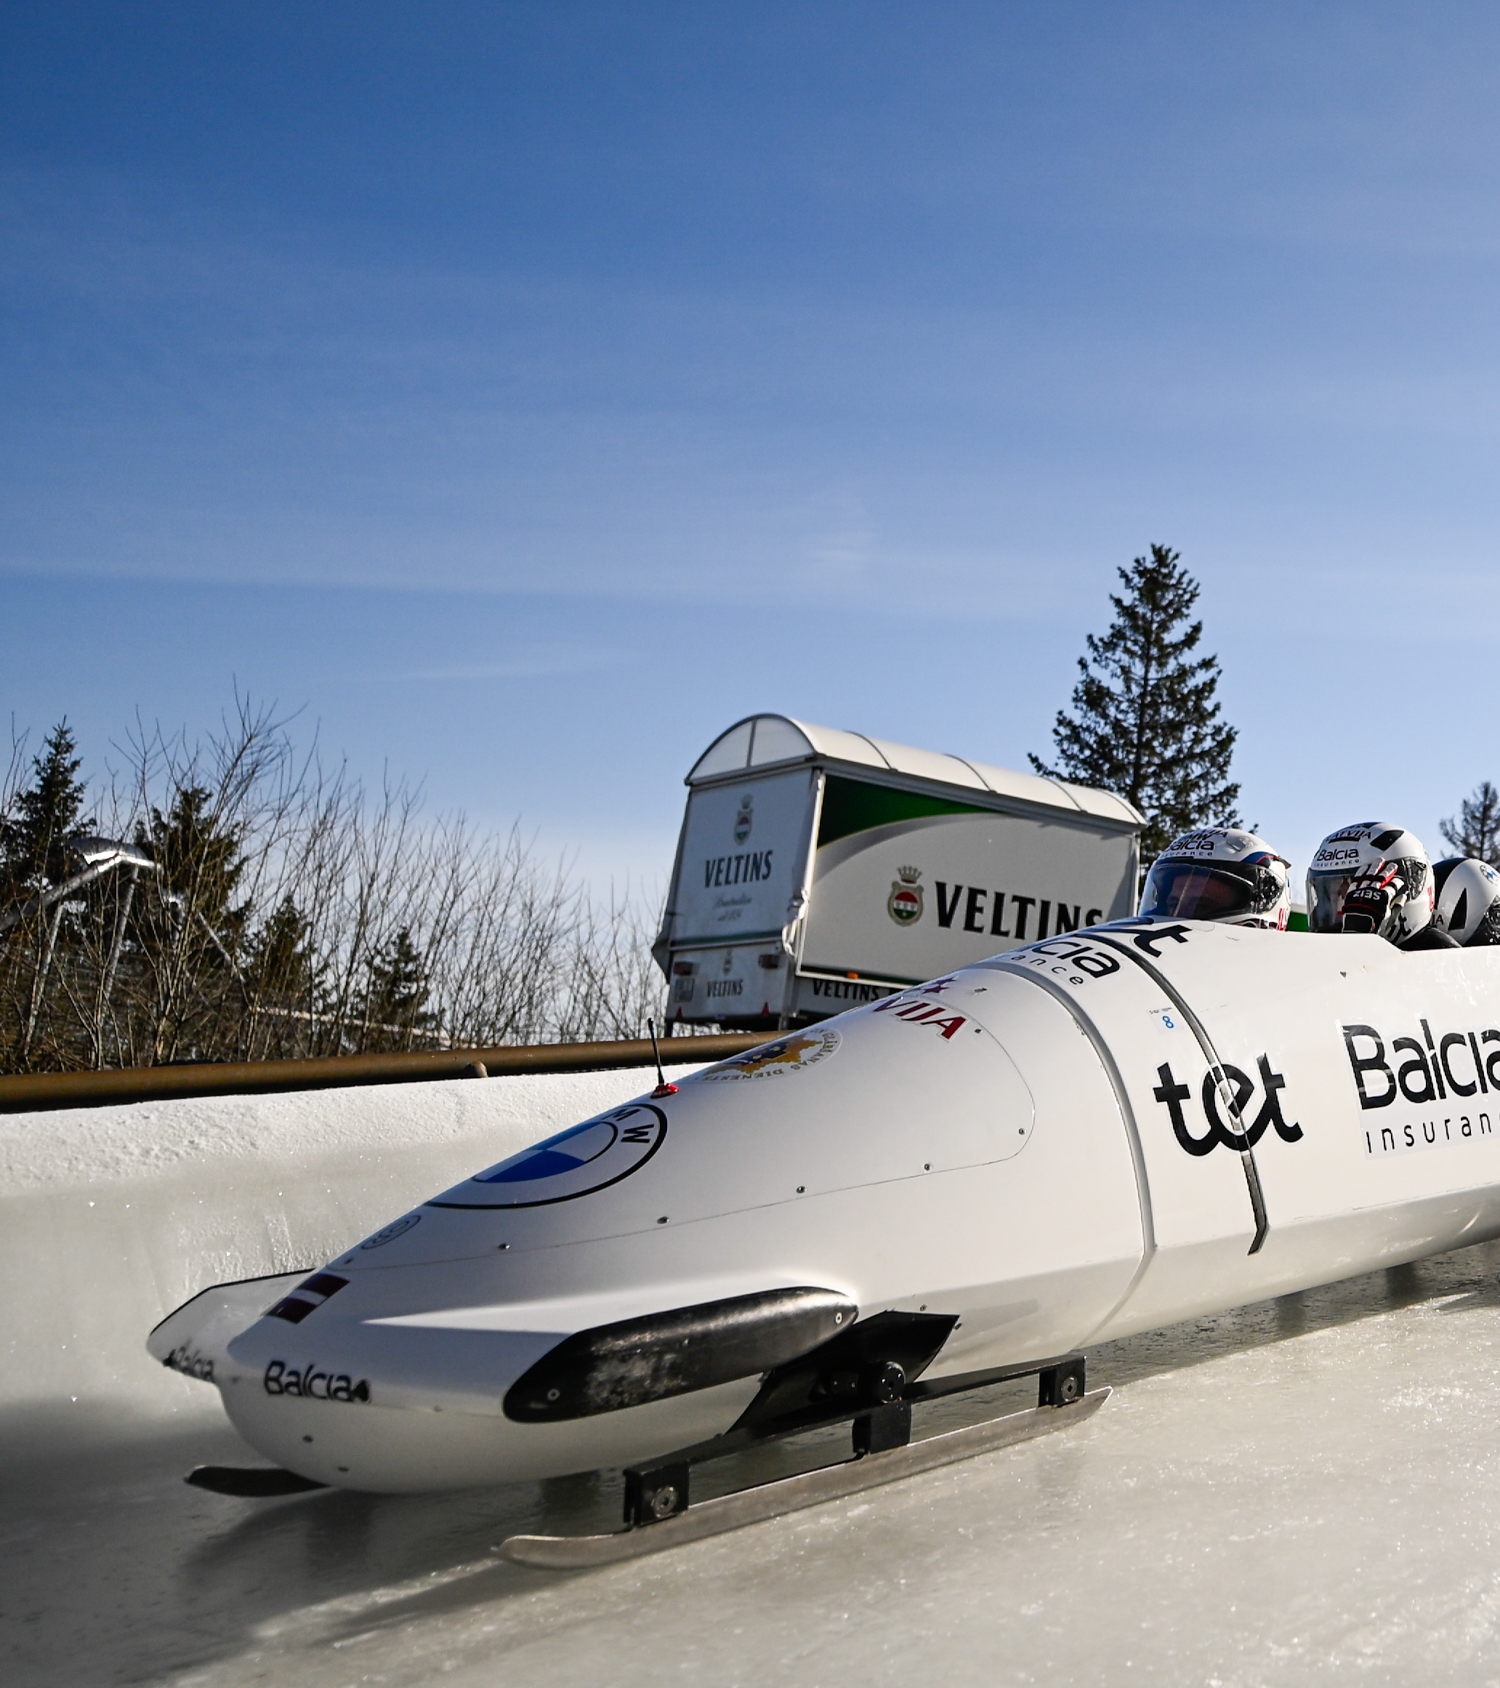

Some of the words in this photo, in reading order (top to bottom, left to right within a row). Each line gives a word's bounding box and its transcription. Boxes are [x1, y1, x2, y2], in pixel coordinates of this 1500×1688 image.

[704, 850, 773, 888] VELTINS
[1317, 849, 1359, 861] Balcia
[1352, 889, 1382, 901] SEIZ
[707, 979, 743, 998] VELTINS
[813, 980, 880, 1002] VELTINS
[872, 996, 966, 1040] VIJA
[1162, 1015, 1175, 1029] 8
[1153, 1053, 1304, 1157] tet
[601, 1109, 655, 1144] MW
[264, 1361, 353, 1403] Balcia
